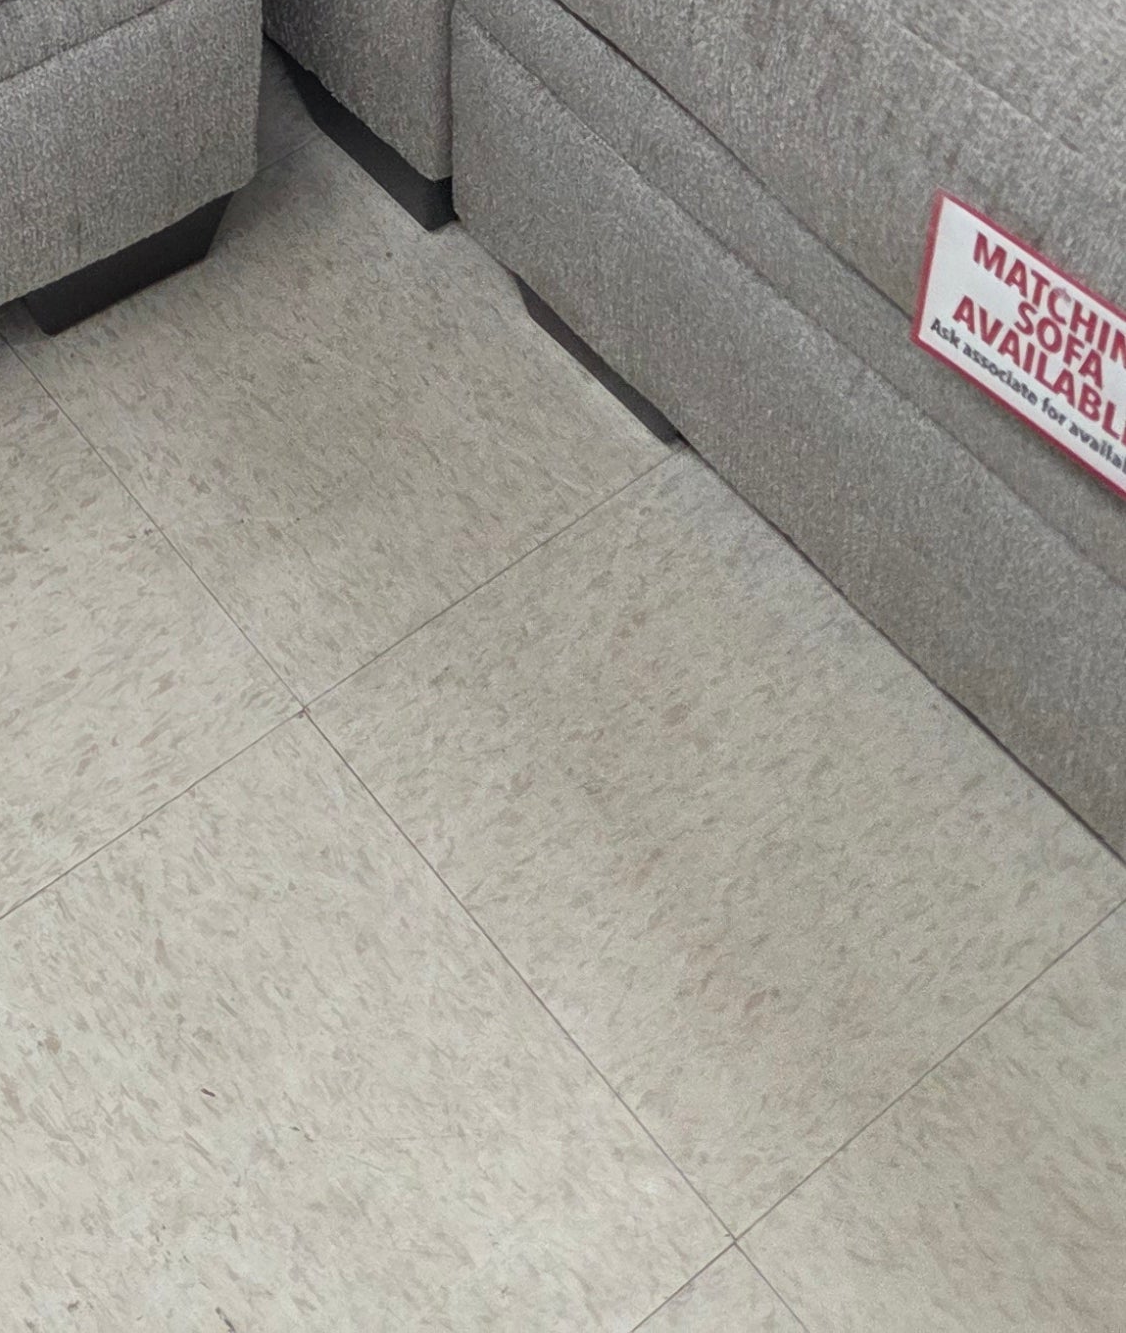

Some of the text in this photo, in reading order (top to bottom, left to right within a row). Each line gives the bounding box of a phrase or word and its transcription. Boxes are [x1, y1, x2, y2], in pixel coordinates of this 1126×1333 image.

[930, 317, 1126, 475] Ask associate for availa
[952, 294, 1126, 448] AVAILABL
[1014, 300, 1104, 391] SOFA
